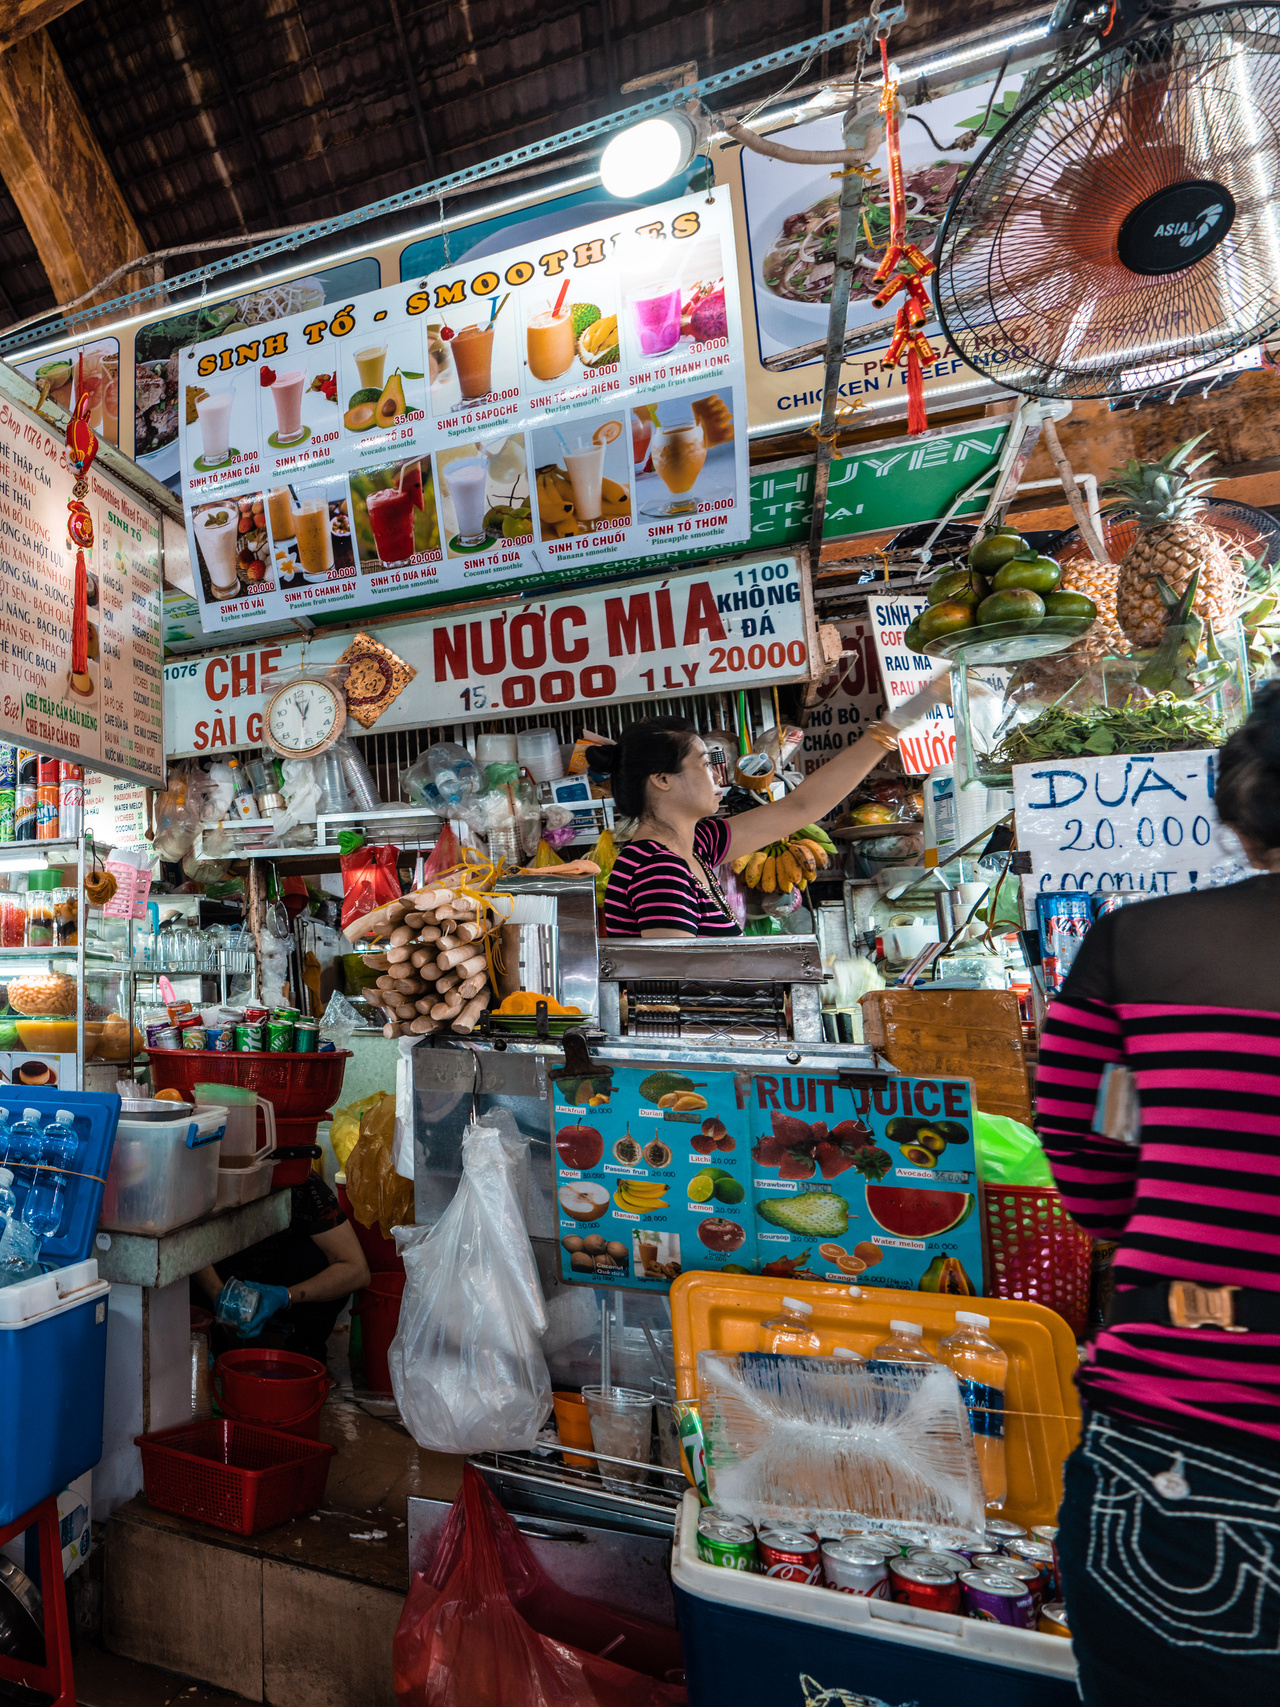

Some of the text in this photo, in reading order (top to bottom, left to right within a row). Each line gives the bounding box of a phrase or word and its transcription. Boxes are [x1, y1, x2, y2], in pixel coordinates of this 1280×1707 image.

[1154, 224, 1188, 238] ASIA
[197, 211, 701, 378] SINH TỐ SMOOTHES
[689, 337, 727, 355] 30.000
[582, 364, 618, 381] 50.000
[629, 354, 730, 387] SINH TỐ THANH LONG
[487, 387, 519, 404] 20.000
[394, 410, 425, 425] 35.000
[437, 403, 519, 431] SINH TỐ SAPOCHE
[311, 431, 339, 445] 30.000
[232, 450, 258, 464] 20.000
[275, 455, 296, 468] SINH
[298, 448, 311, 464] TỐ
[13, 451, 33, 474] THẬP
[34, 466, 51, 488] CẨM
[12, 472, 17, 483] 3
[19, 475, 37, 496] MÀU
[13, 489, 31, 511] THÁI
[697, 498, 734, 513] 20.000
[12, 507, 22, 525] BỔ
[25, 517, 51, 542] LƯỢNG
[108, 511, 129, 534] SINH
[596, 516, 631, 532] 20.000
[648, 515, 728, 537] SINH TỐ THƠM
[501, 534, 533, 548] 20.000
[548, 530, 626, 555] SINH TỐ CHUỐI
[651, 527, 725, 546] Pineapple smoothie
[410, 550, 441, 566] 20.000
[464, 551, 521, 570] SINH TỐ DỪA
[557, 546, 618, 562] Banana smoothie
[12, 547, 35, 570] XANH
[36, 558, 58, 582] BÁNH
[326, 566, 356, 580] 20.000
[370, 565, 437, 588] SINH TỐ DƯA HẤU
[733, 563, 789, 586] 1100
[247, 581, 275, 594] 20.000
[284, 581, 357, 603] SINH TỐ CHANH DÂY
[717, 582, 800, 613] KHÔNG
[741, 609, 776, 638] ĐÁ
[876, 604, 911, 627] SINH
[433, 580, 728, 682] NƯỚC MÍA
[19, 627, 35, 646] SEN
[41, 638, 66, 660] THẠCH
[12, 643, 34, 664] KHÚC
[35, 654, 56, 674] BẠCH
[709, 640, 807, 674] 20.000
[885, 656, 910, 672] RAU
[164, 664, 197, 680] 1076
[460, 665, 616, 715] 15.000
[26, 691, 38, 711] CHÈ
[39, 696, 55, 719] THẬP
[838, 706, 860, 724] BÒ
[193, 708, 237, 751] SÀI
[113, 782, 136, 791] PINEAPPLE
[1059, 816, 1211, 851] 20.000
[733, 1075, 839, 1114] FRUIT
[557, 1106, 585, 1115] Jackfruit
[640, 1109, 663, 1117] Durian
[690, 1155, 711, 1163] Litchi
[561, 1170, 579, 1178] Apple
[605, 1165, 646, 1176] Passion fruit
[896, 1169, 932, 1179] Avocado
[756, 1180, 796, 1190] Strawberry
[614, 1211, 640, 1220] Banana
[688, 1203, 713, 1212] Lemon
[759, 1232, 790, 1241] Soursop
[873, 1236, 924, 1249] Water melon
[827, 1273, 856, 1282] Orange
